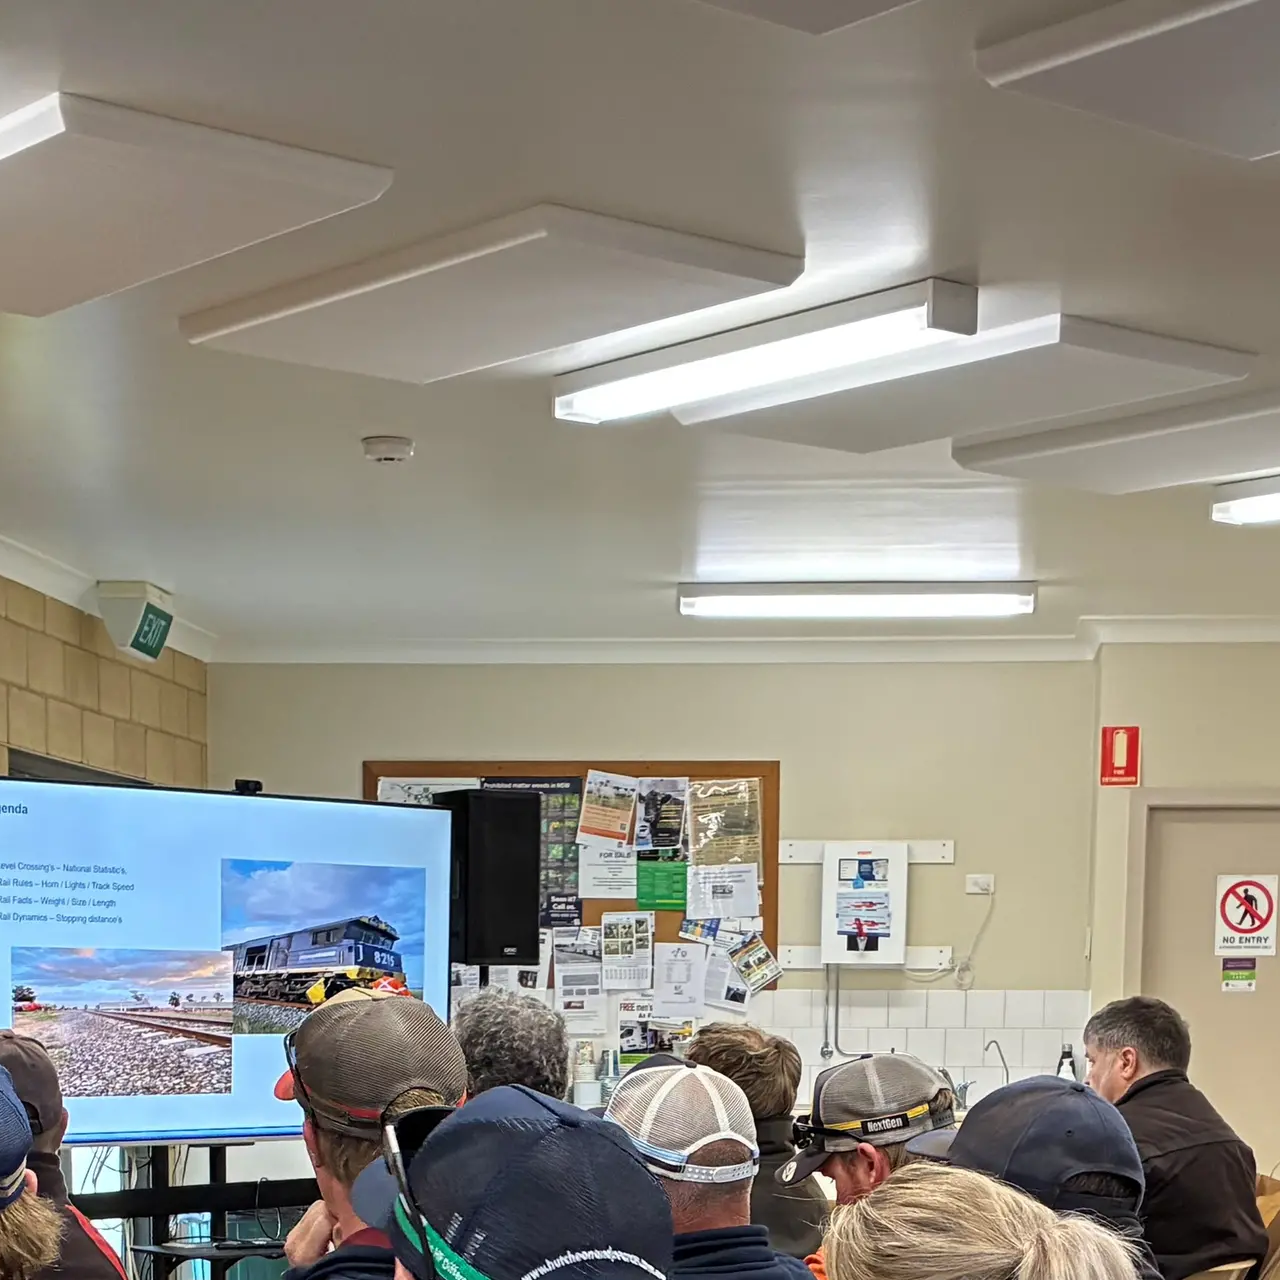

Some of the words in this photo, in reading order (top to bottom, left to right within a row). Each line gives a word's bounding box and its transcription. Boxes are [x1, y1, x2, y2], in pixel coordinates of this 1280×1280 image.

[139, 613, 167, 648] EXIT
[62, 864, 91, 873] National
[12, 878, 33, 888] Rules
[65, 881, 86, 891] Lights
[91, 882, 110, 890] Track
[112, 882, 135, 893] Speed
[12, 895, 33, 905] Facts
[40, 897, 66, 907] Weight
[71, 898, 87, 906] Size
[92, 899, 116, 909] Length
[13, 912, 48, 923] Dynamics
[55, 914, 87, 924] Stopping
[1222, 936, 1235, 944] NO
[1239, 936, 1269, 944] ENTRY
[374, 951, 395, 967] 8215
[619, 1003, 635, 1011] FREE
[867, 1117, 903, 1132] NextGen
